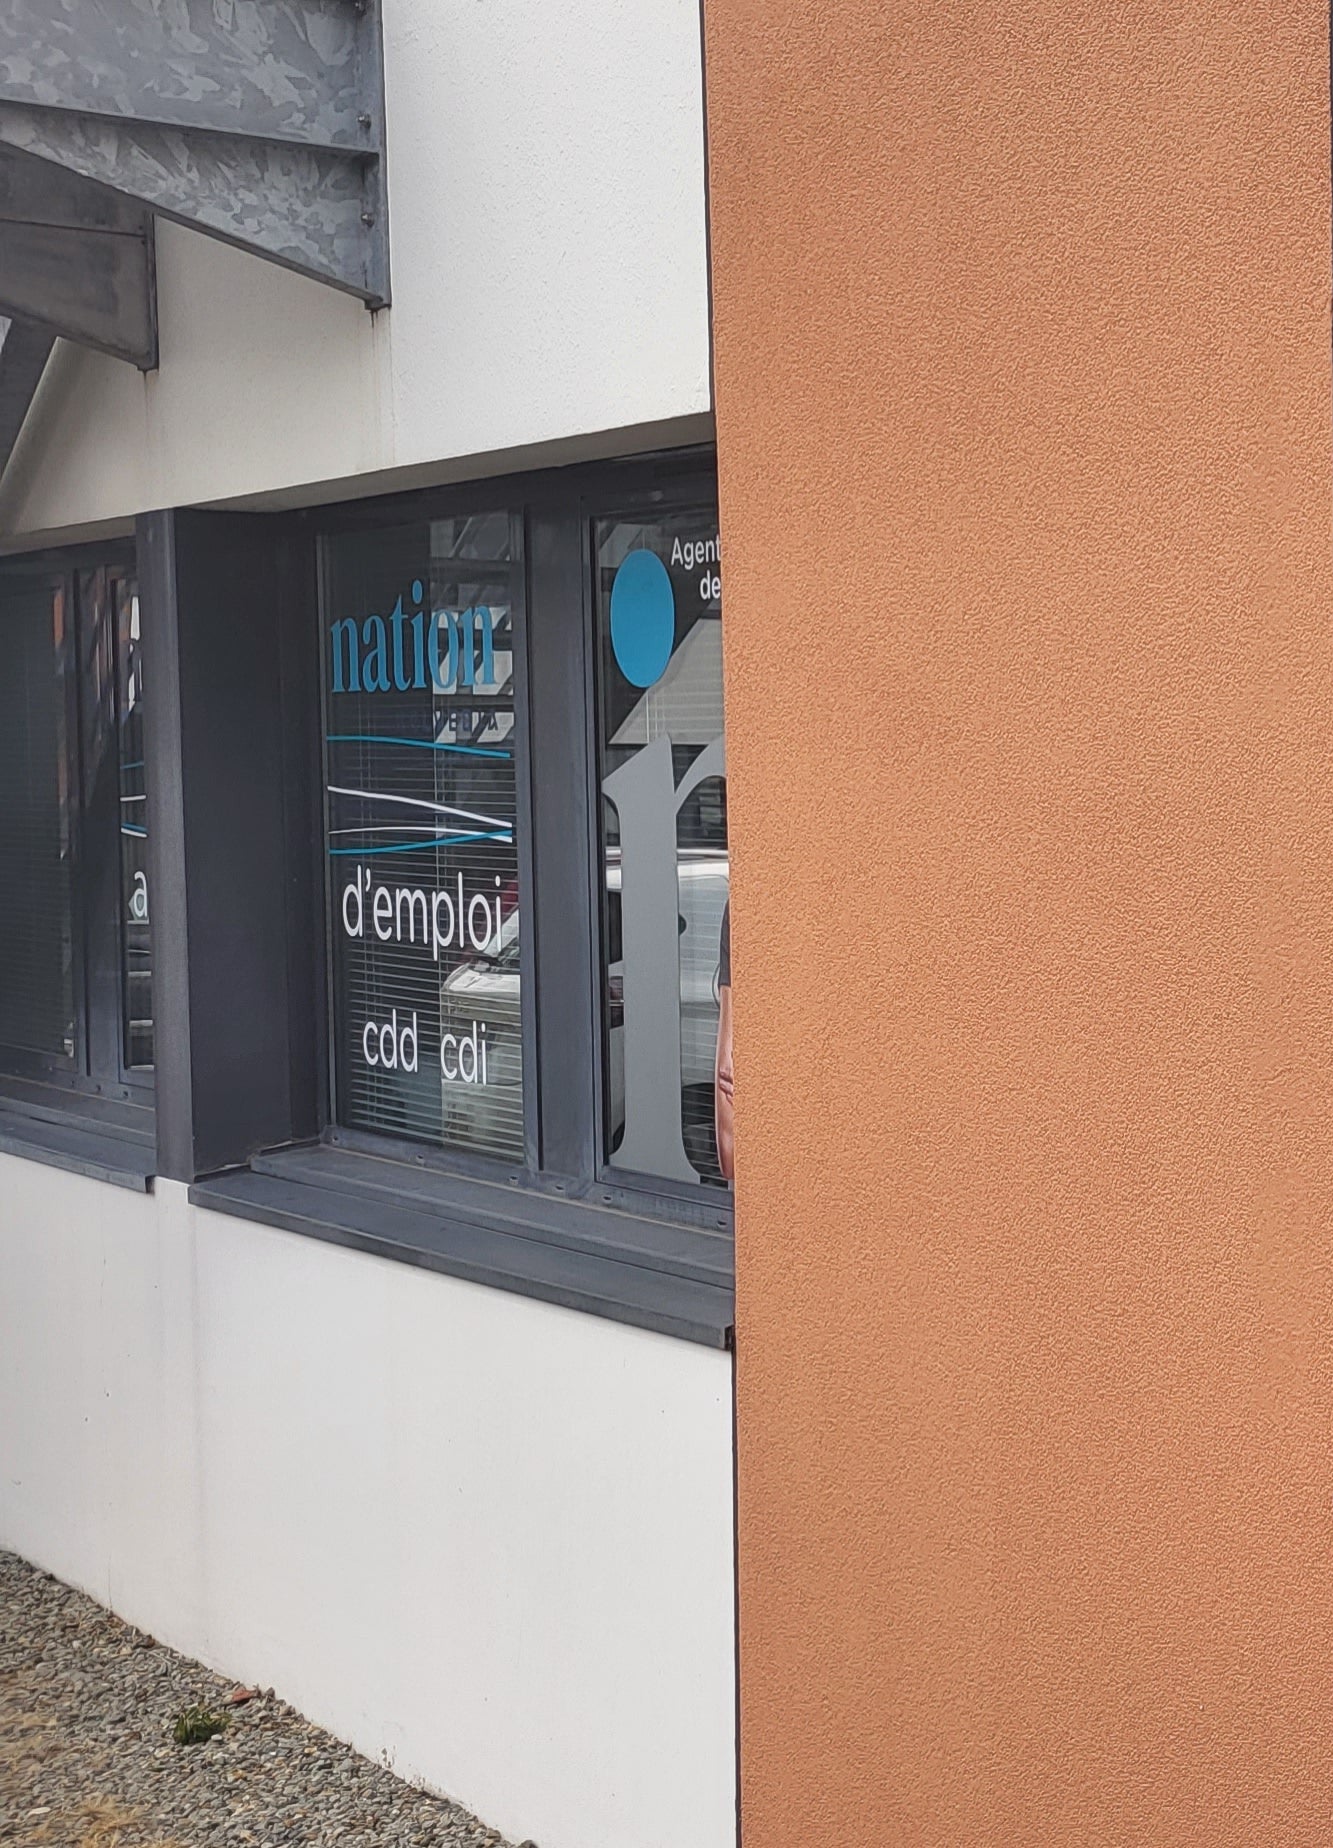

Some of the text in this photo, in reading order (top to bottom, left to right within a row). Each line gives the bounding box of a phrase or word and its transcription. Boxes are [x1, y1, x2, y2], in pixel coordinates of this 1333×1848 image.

[330, 579, 497, 693] nation
[342, 864, 503, 962] d'emploi
[363, 1008, 487, 1086] cdd cdi
